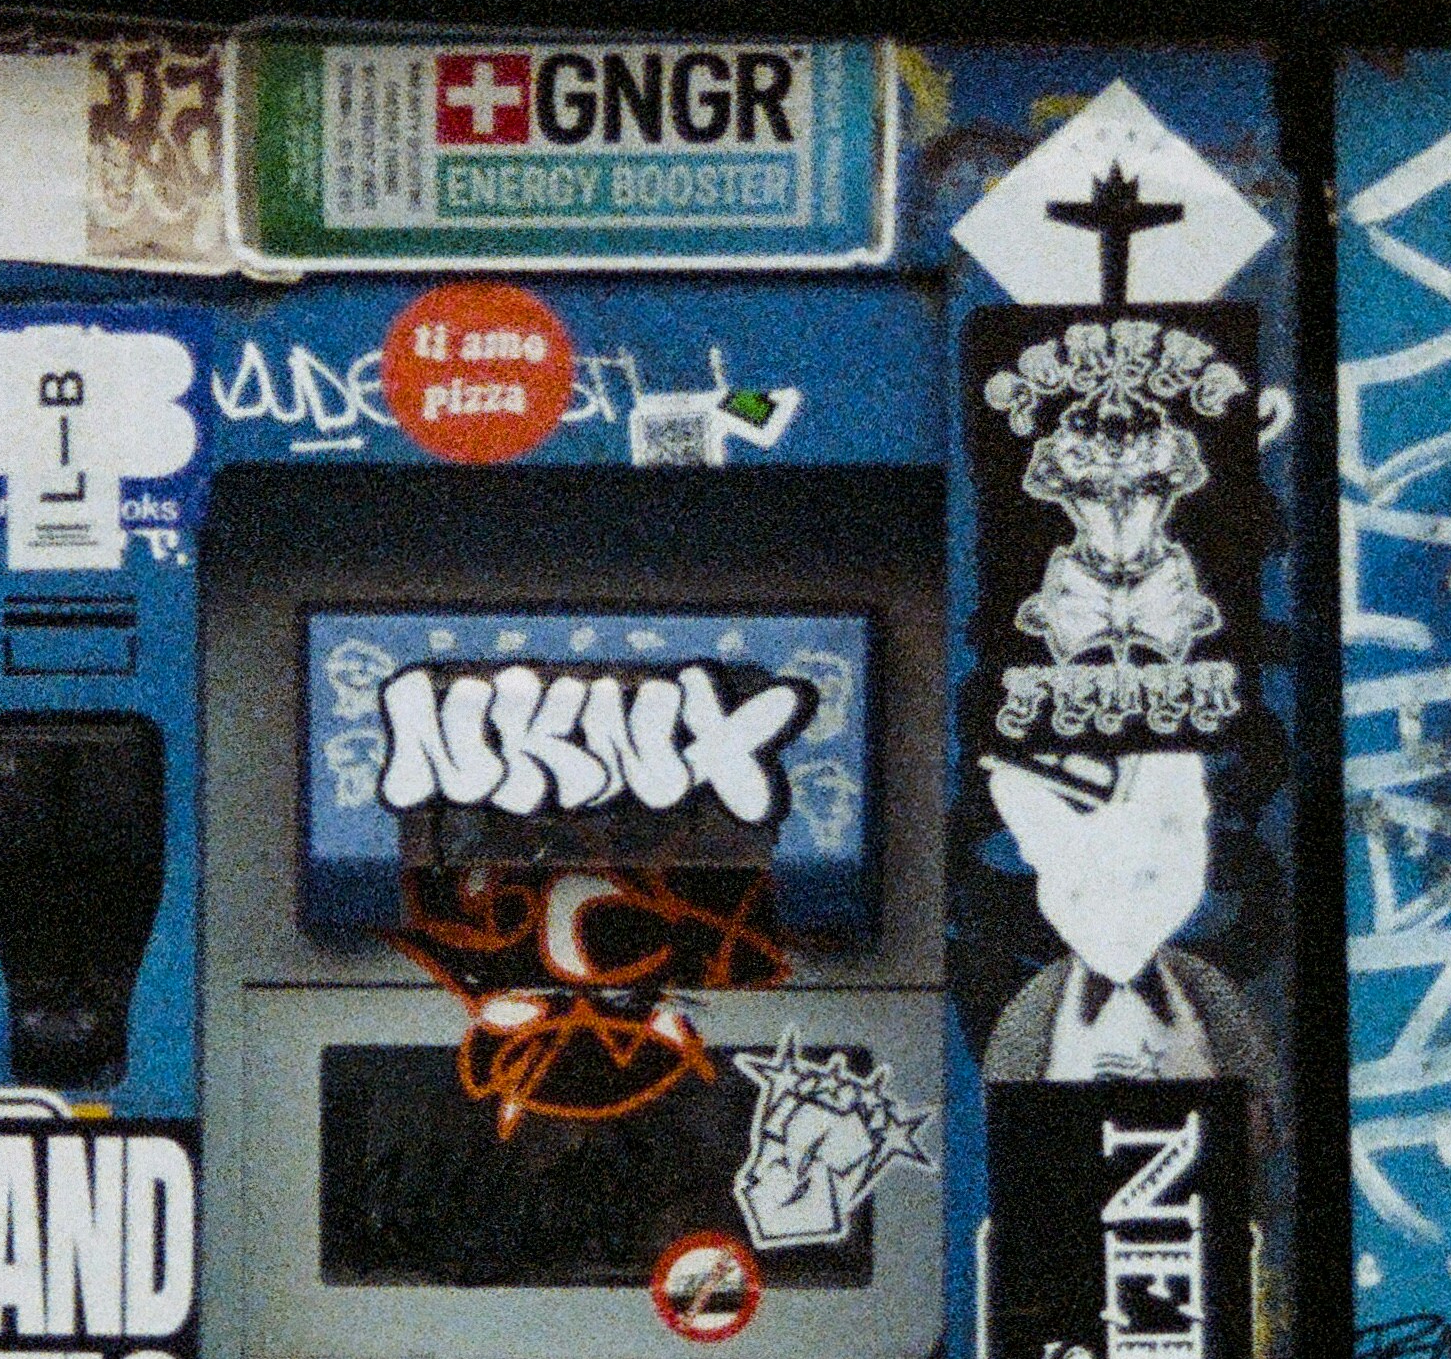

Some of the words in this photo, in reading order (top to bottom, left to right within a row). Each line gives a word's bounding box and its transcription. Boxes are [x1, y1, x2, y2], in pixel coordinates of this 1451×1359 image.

[535, 51, 796, 147] GNGR
[445, 160, 599, 211] ENERGY
[609, 160, 789, 211] BOOSTER
[459, 323, 547, 363] amo
[422, 377, 527, 422] pizza
